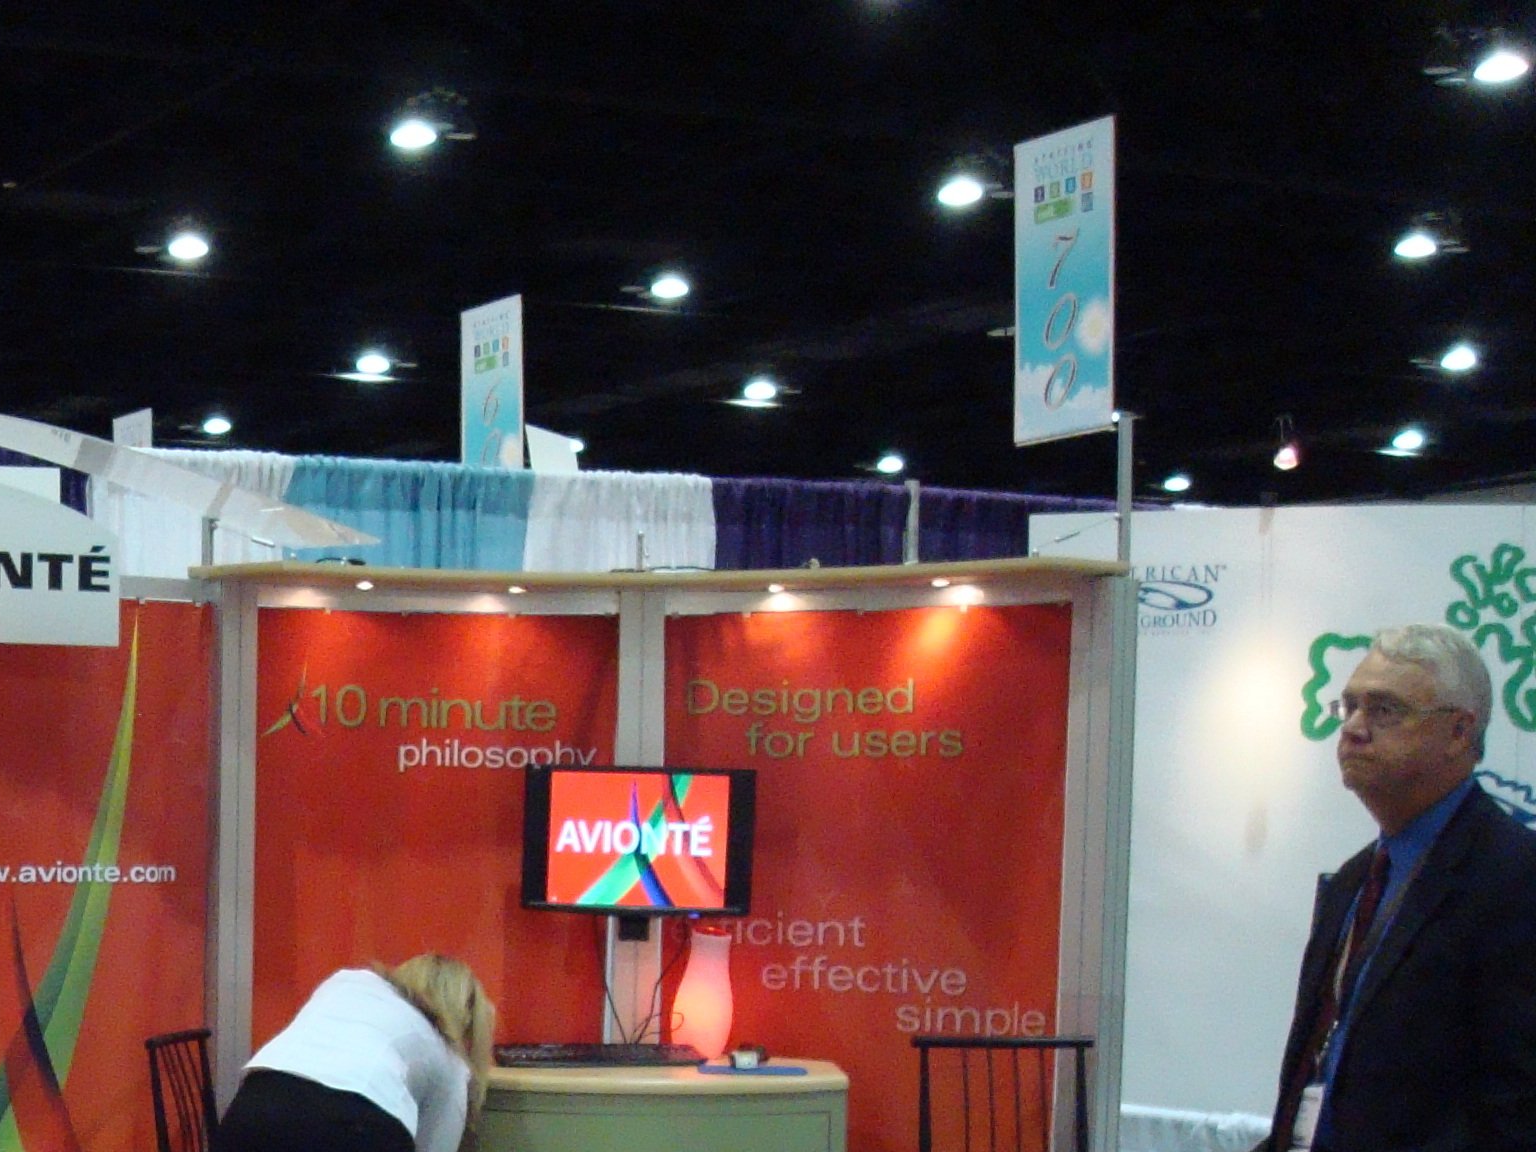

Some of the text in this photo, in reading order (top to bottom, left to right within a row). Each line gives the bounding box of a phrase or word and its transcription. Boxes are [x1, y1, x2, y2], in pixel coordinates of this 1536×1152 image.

[312, 684, 557, 733] 10 minute
[687, 676, 913, 724] Designed
[746, 723, 964, 758] for users
[556, 816, 712, 857] AVIONTÉ
[763, 955, 966, 995] effective
[895, 998, 1046, 1040] simple
